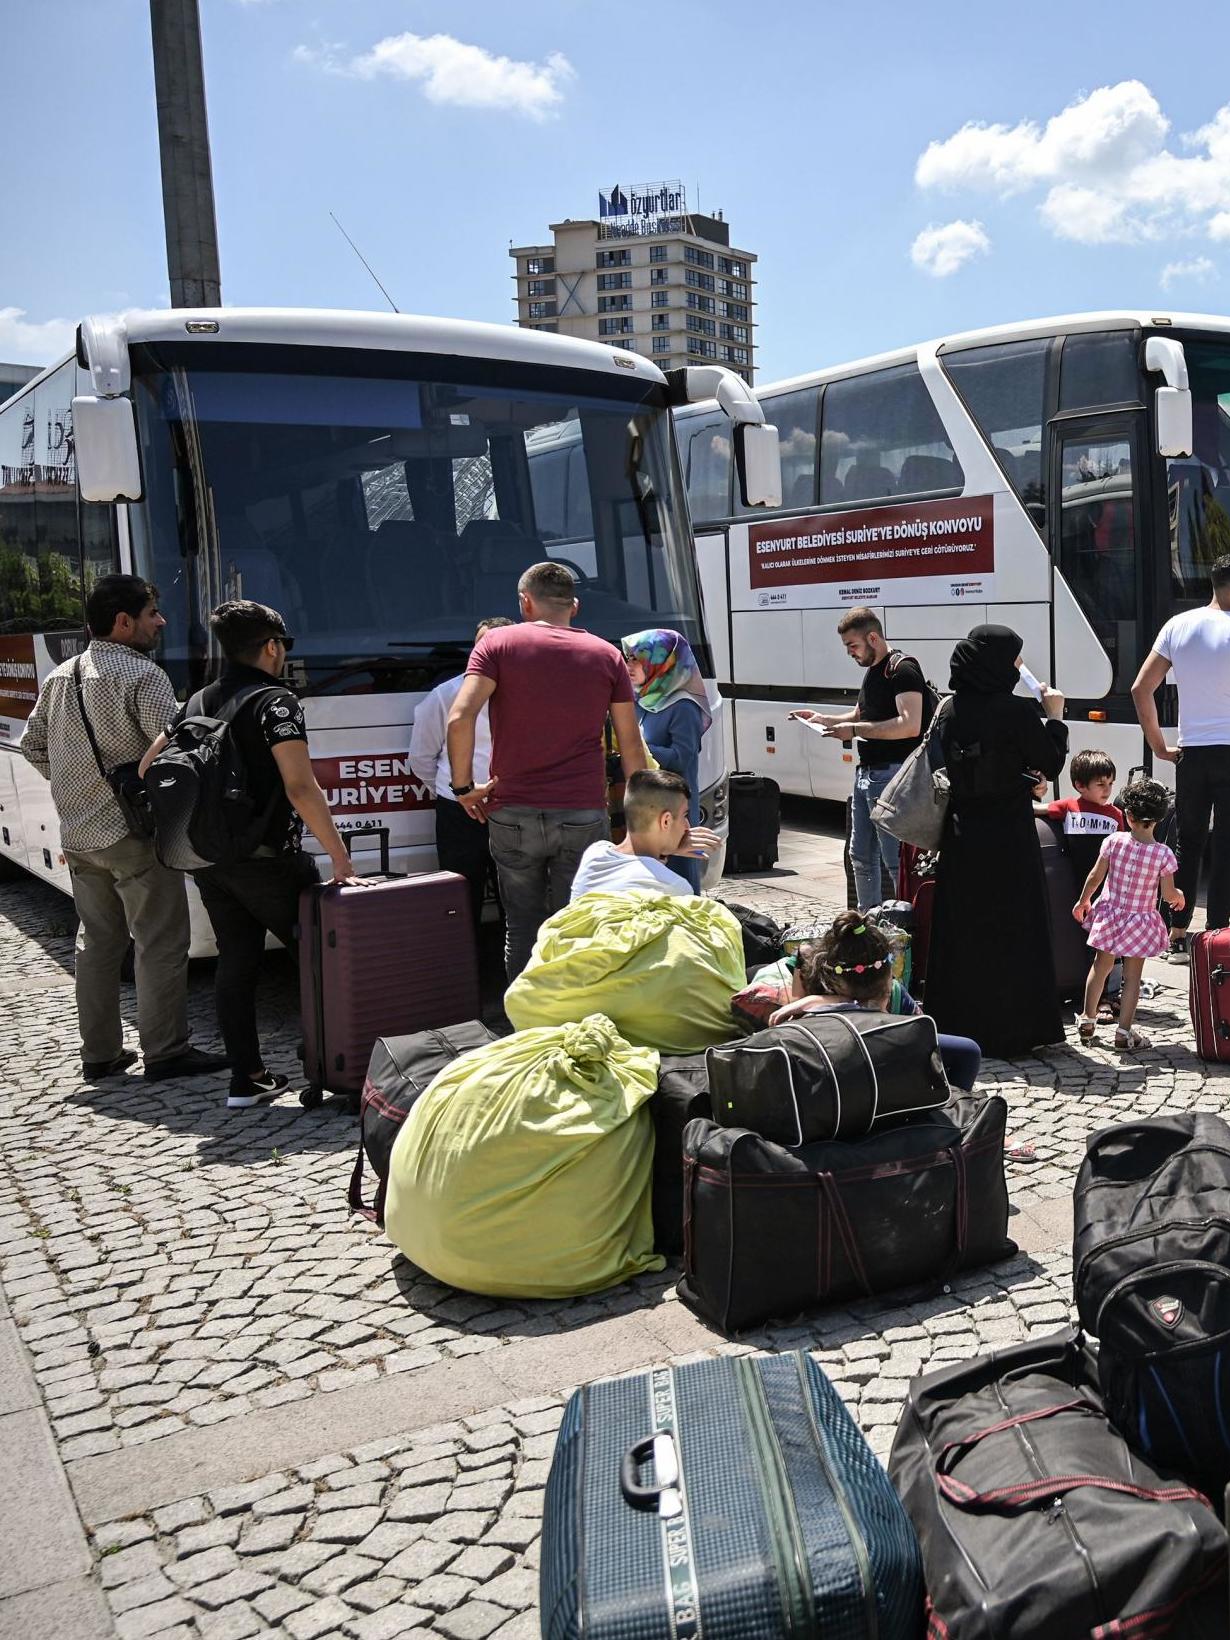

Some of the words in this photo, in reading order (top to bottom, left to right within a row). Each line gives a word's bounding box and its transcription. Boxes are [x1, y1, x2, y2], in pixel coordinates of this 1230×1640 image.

[756, 537, 796, 554] ESENYURT
[797, 529, 845, 549] BELEDİYESİ
[846, 525, 893, 544] SURİYE'YE
[894, 519, 928, 540] DÖNÜŞ
[929, 516, 982, 536] KONVOYU
[339, 759, 412, 779] ESEN
[322, 781, 432, 807] URİYE'Y
[654, 1390, 673, 1423] SUPER
[667, 1528, 689, 1567] SUPER
[673, 1581, 697, 1625] BAG
